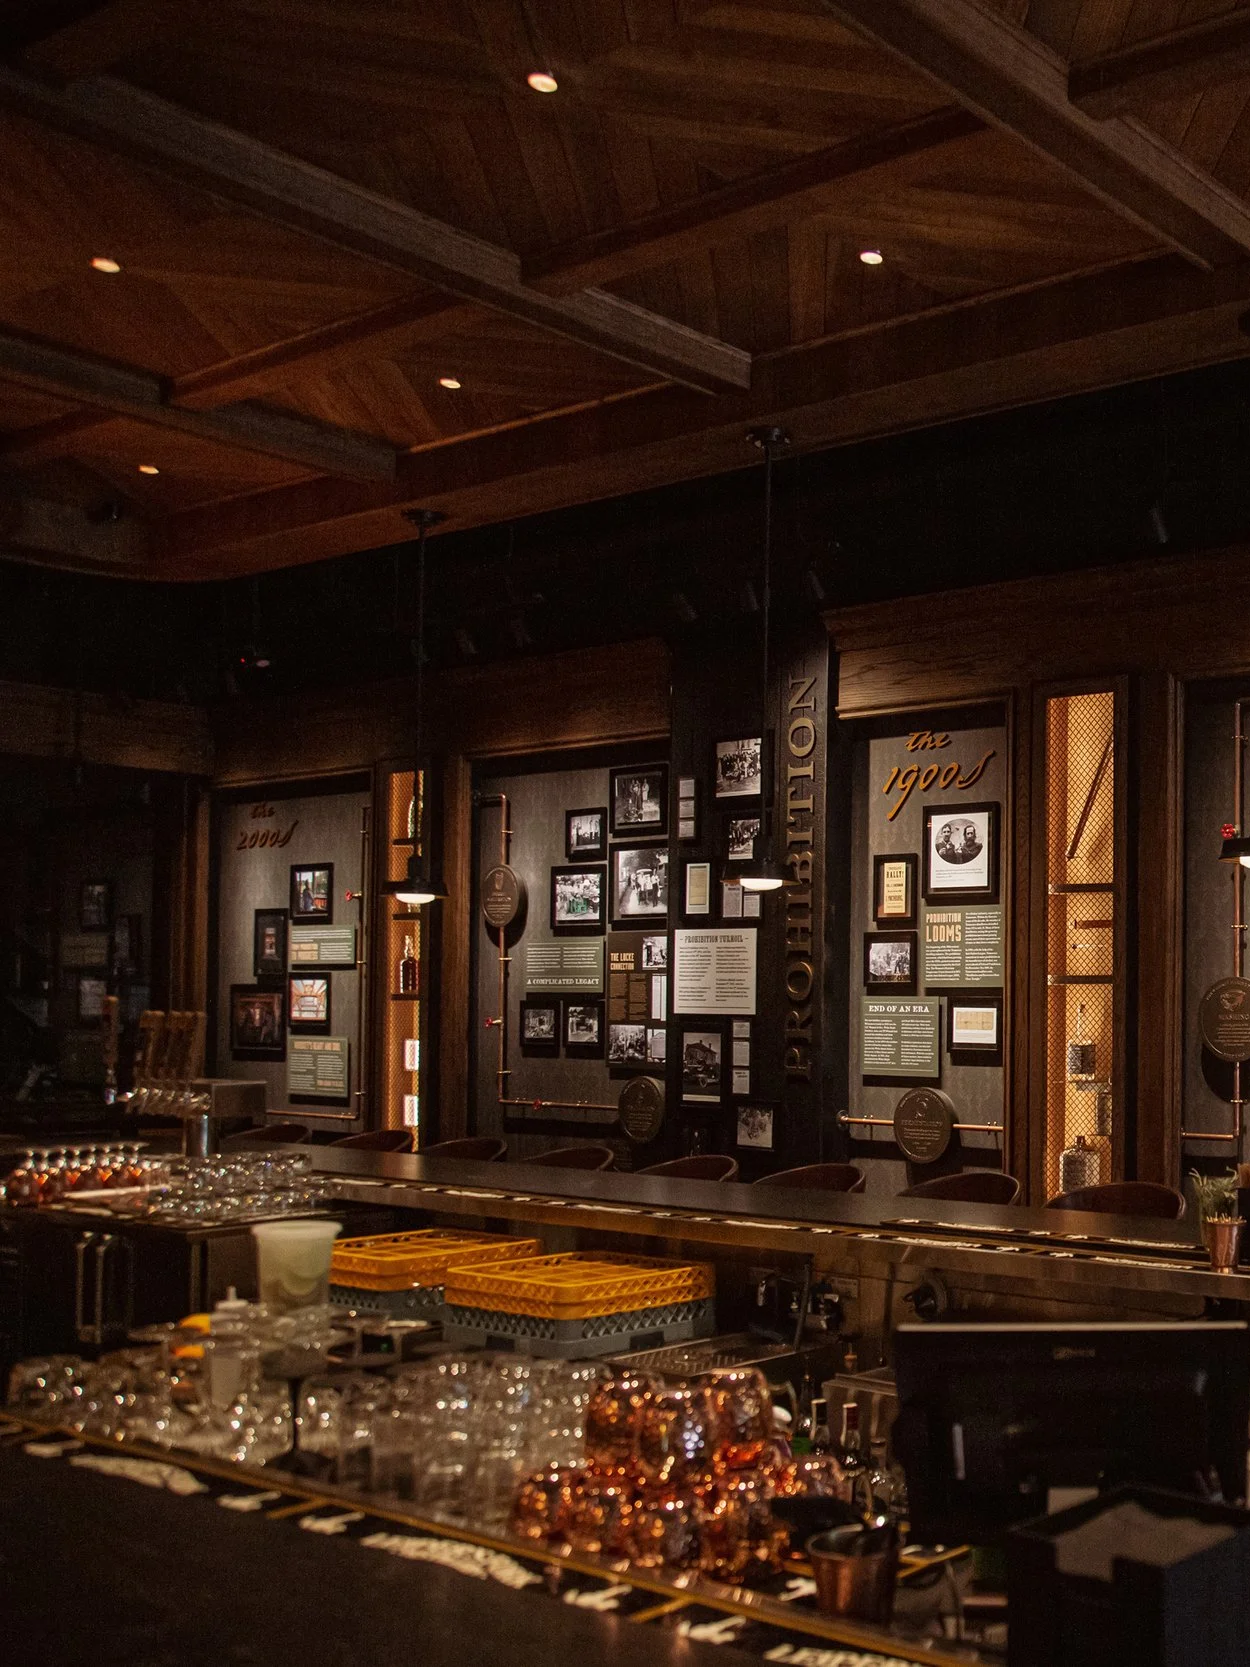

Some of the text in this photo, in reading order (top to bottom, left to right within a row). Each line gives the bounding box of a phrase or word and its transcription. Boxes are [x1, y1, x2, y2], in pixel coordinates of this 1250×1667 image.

[905, 730, 949, 751] the
[882, 751, 994, 821] 1900s
[785, 676, 815, 1075] PROHIBITION
[926, 912, 962, 923] PROHIBITION
[684, 935, 718, 944] PROHIBITION
[926, 924, 962, 943] LOOMS
[610, 952, 619, 961] THE
[898, 1005, 911, 1013] AN
[912, 1005, 930, 1013] ERA
